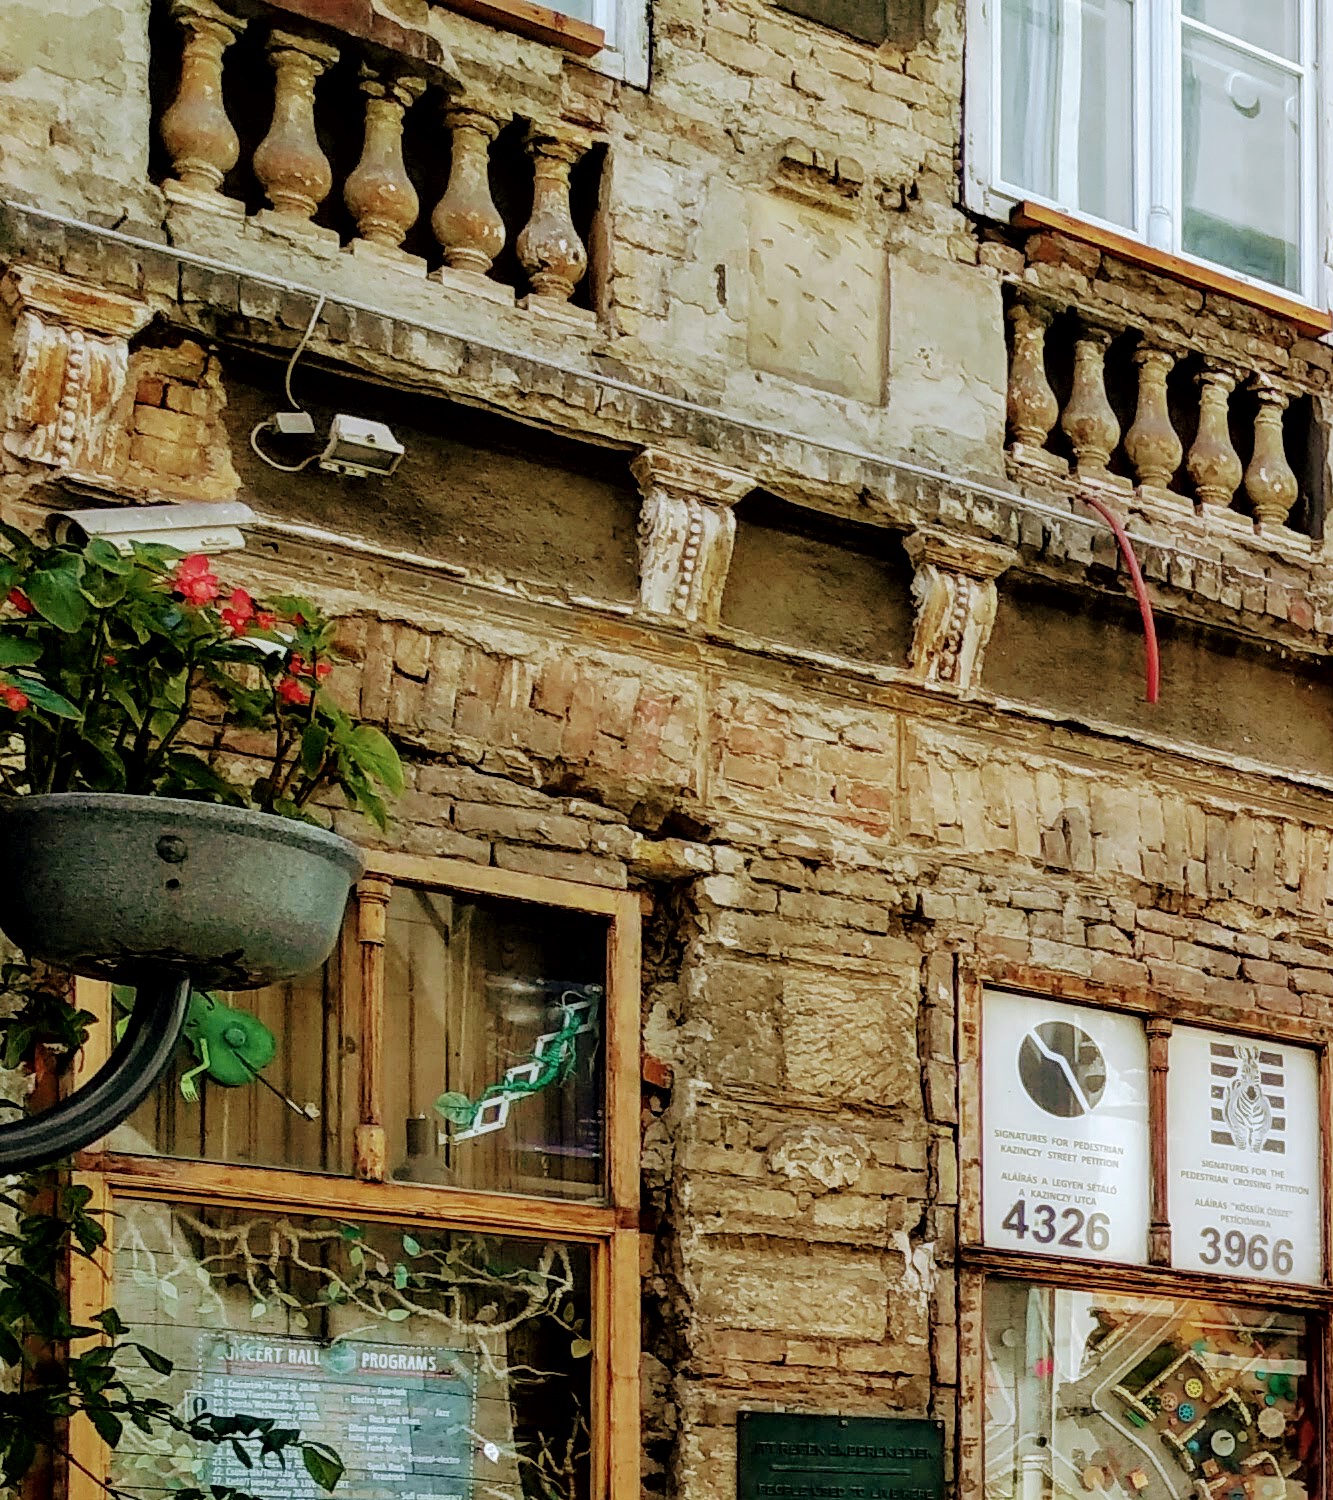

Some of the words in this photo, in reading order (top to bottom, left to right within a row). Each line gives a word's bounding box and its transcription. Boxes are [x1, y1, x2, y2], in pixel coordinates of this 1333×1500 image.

[994, 1129, 1047, 1144] SIGNATURES
[1051, 1137, 1069, 1148] FOR
[1074, 1141, 1124, 1155] PEDESTRIAN
[1001, 1144, 1042, 1158] KAZINCZY
[1048, 1151, 1077, 1163] STREET
[1081, 1156, 1119, 1169] PETITION
[1201, 1160, 1249, 1174] SIGNATURES
[1251, 1167, 1267, 1177] FOR
[1270, 1169, 1285, 1179] THE
[1052, 1178, 1084, 1190] LEGYEN
[1180, 1170, 1229, 1184] PEDESTRIAN
[1233, 1178, 1272, 1190] CROSSING
[1275, 1184, 1309, 1195] PETITION
[1018, 1188, 1025, 1197] A
[1030, 1190, 1071, 1202] KAZINCZY
[1074, 1196, 1097, 1206] UTCA
[1002, 1199, 1111, 1251] 4326
[1199, 1226, 1294, 1276] 3966
[288, 1349, 321, 1366] HALL
[362, 1352, 437, 1371] PROGRAMS
[757, 1483, 808, 1496] PEOPLE
[809, 1485, 845, 1498] USED
[849, 1486, 865, 1498] TO
[870, 1488, 899, 1499] LIVE
[900, 1488, 935, 1500] HERE
